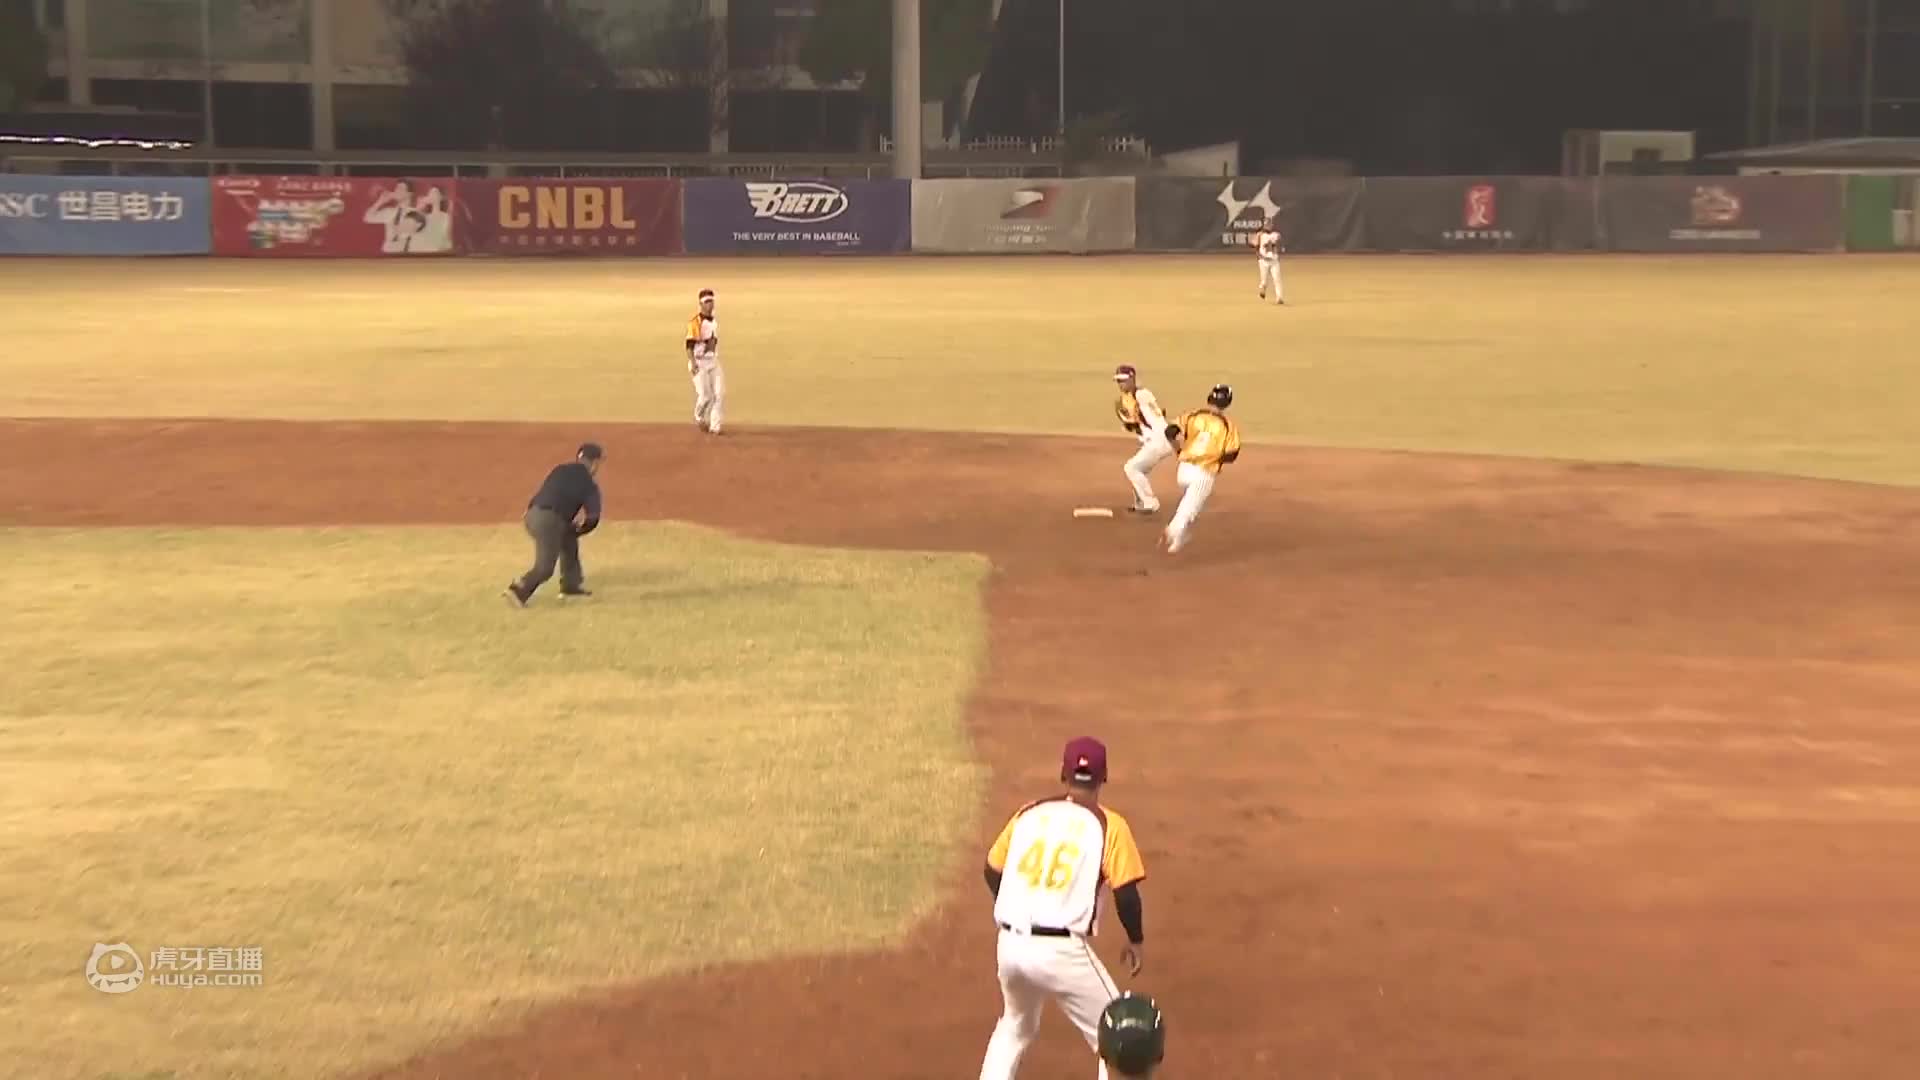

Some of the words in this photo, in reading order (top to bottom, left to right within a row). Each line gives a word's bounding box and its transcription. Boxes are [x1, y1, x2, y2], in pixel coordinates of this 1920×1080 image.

[57, 191, 183, 221] 世昌电力
[499, 186, 636, 229] CNBL
[733, 232, 750, 241] THE
[752, 232, 776, 241] VERY
[777, 232, 800, 241] BEST
[802, 232, 812, 241] IN
[813, 232, 860, 241] BASEBALL
[1017, 838, 1079, 889] 46
